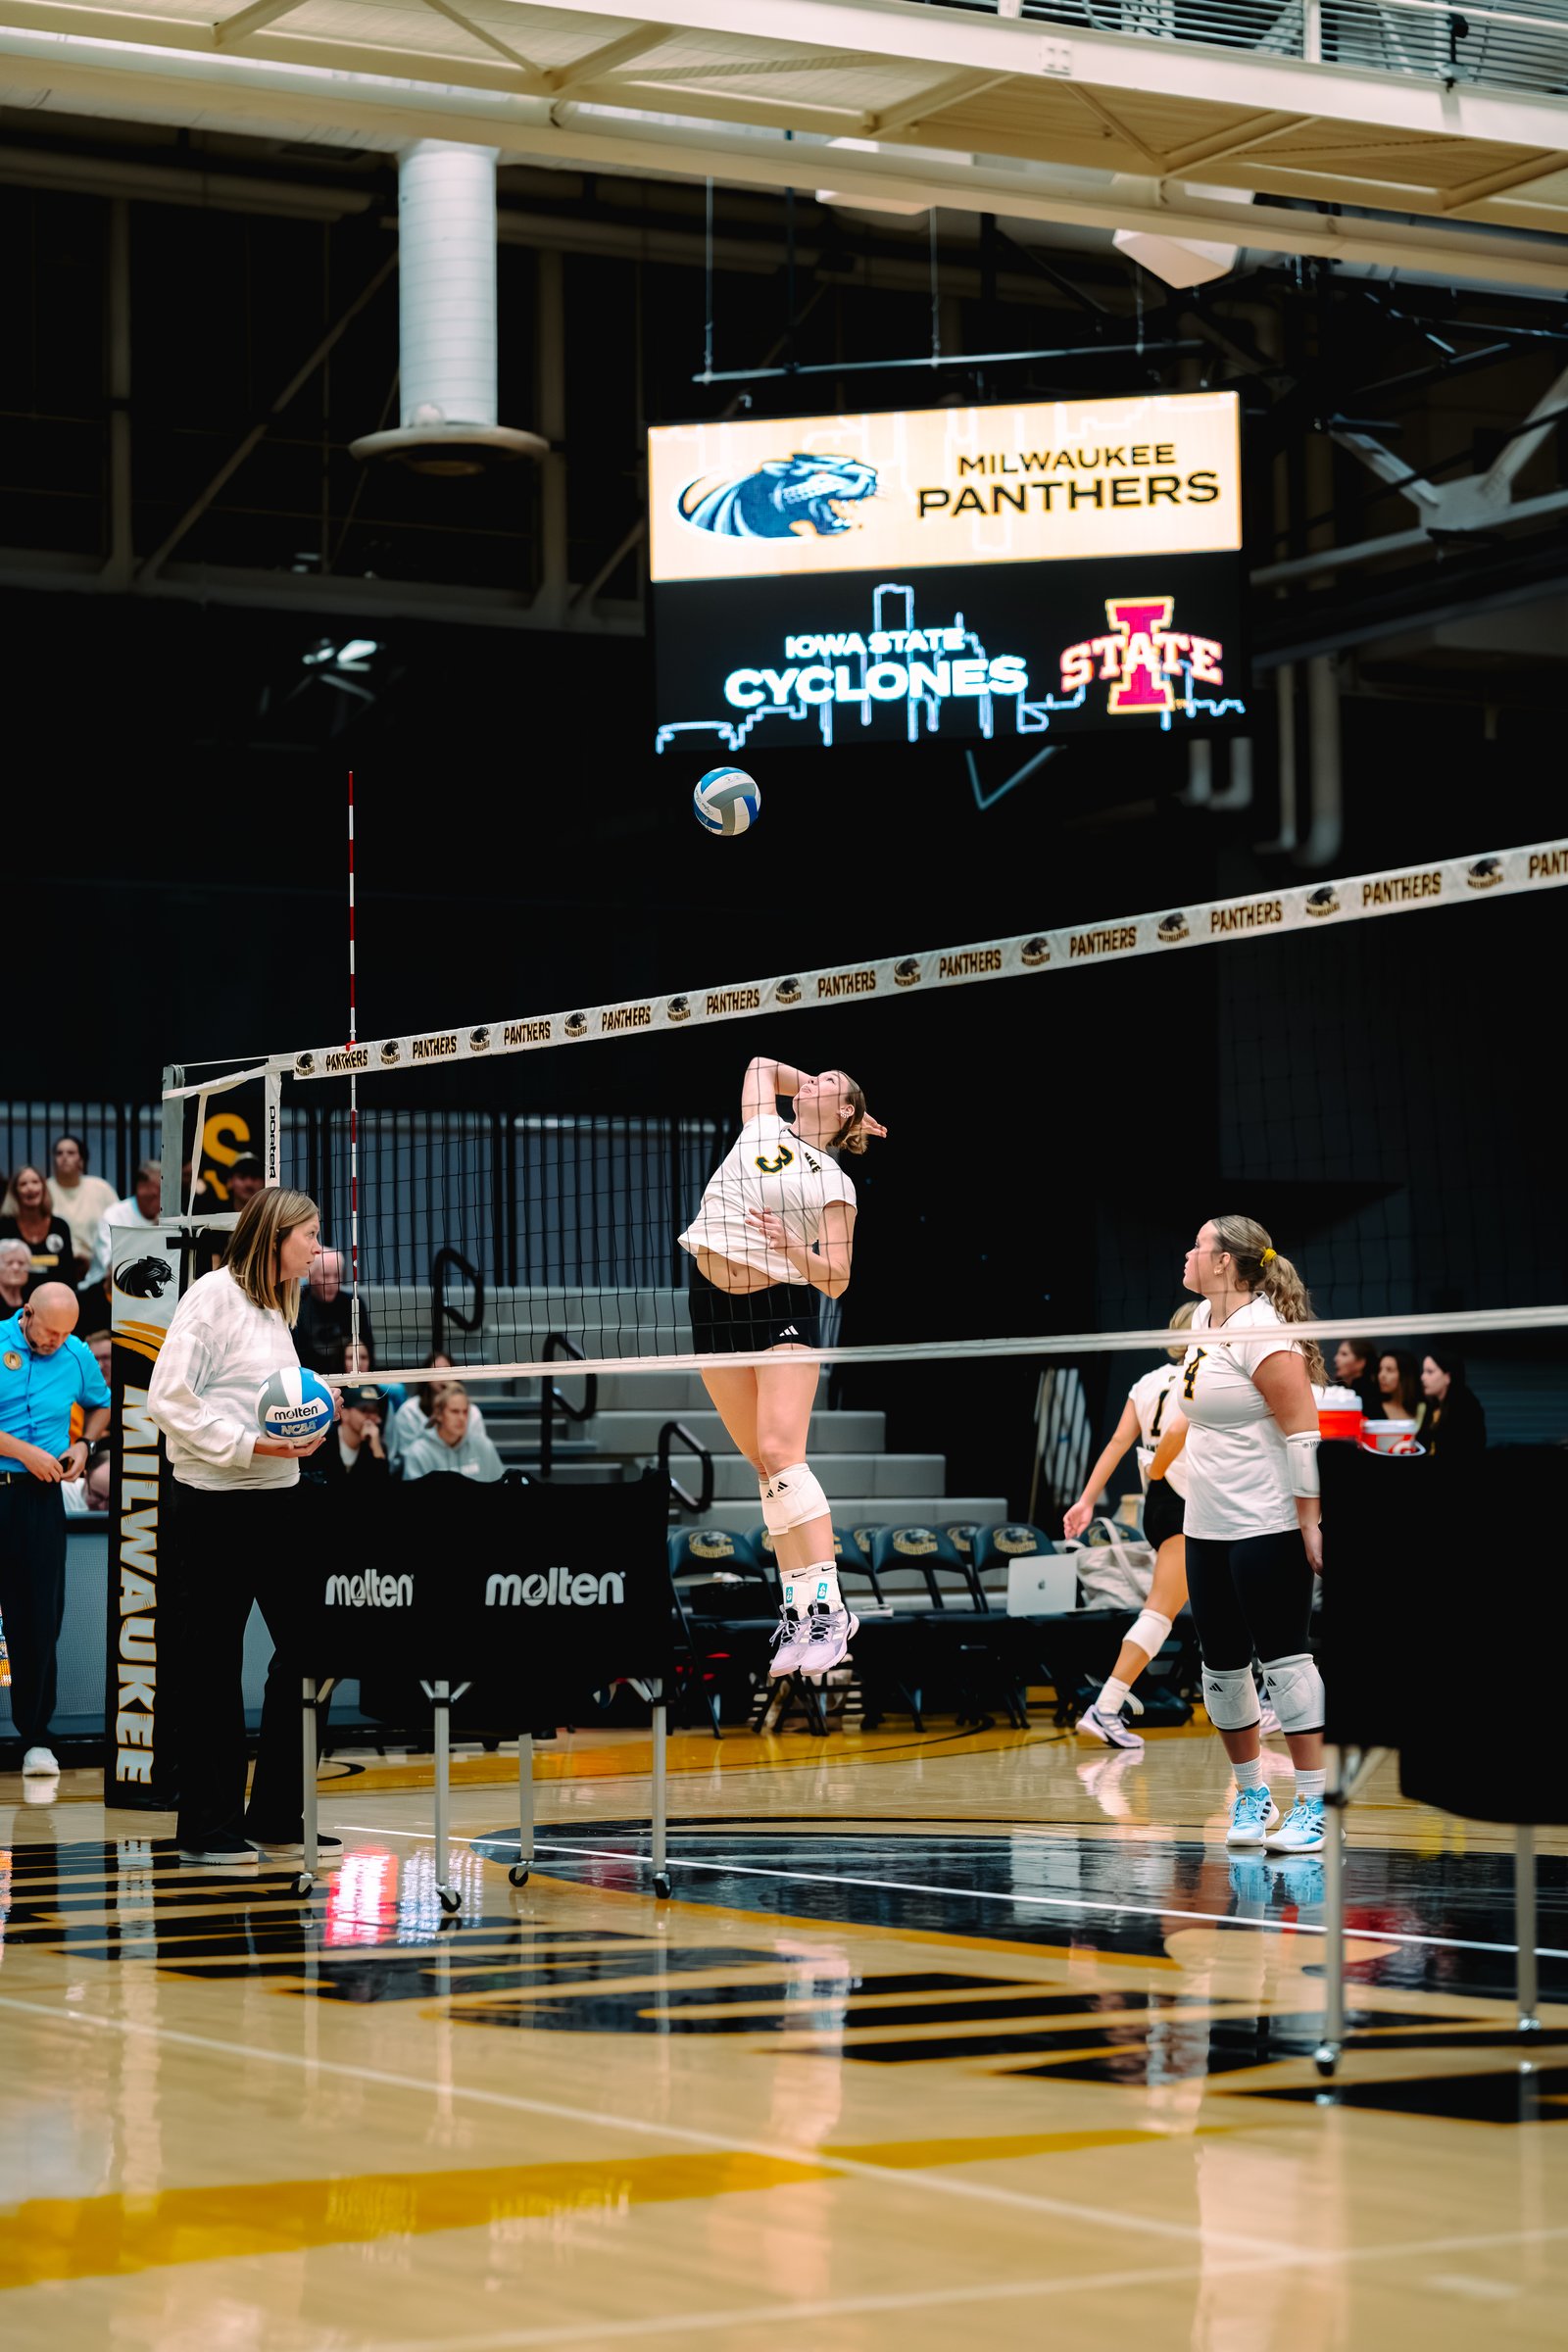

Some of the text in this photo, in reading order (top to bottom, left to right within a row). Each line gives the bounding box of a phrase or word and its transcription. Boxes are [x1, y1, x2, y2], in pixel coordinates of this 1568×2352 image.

[957, 443, 1176, 476] MILWAUKEE
[918, 471, 1220, 518] PANTHERS
[785, 627, 966, 659] IOWA STATE
[1061, 630, 1224, 693] STATE
[724, 655, 1029, 709] CYCLONES
[324, 1049, 369, 1072] PANTHERS
[412, 1034, 458, 1059] PANTHERS
[503, 1019, 552, 1047] PANTHERS
[601, 1004, 652, 1031] PANTHERS
[705, 988, 760, 1015] PANTHERS
[816, 969, 877, 999] PANTHERS
[938, 948, 1003, 979] PANTHERS
[1069, 925, 1137, 958] PANTHERS
[1209, 900, 1283, 934] PANTHERS
[1361, 870, 1442, 907] PANTHERS
[755, 1144, 795, 1174] 3
[274, 1405, 319, 1421] molten
[280, 1420, 318, 1436] NCAA
[115, 1383, 161, 1785] MILWAUKEE
[324, 1568, 414, 1608] molten
[485, 1567, 626, 1607] molten
